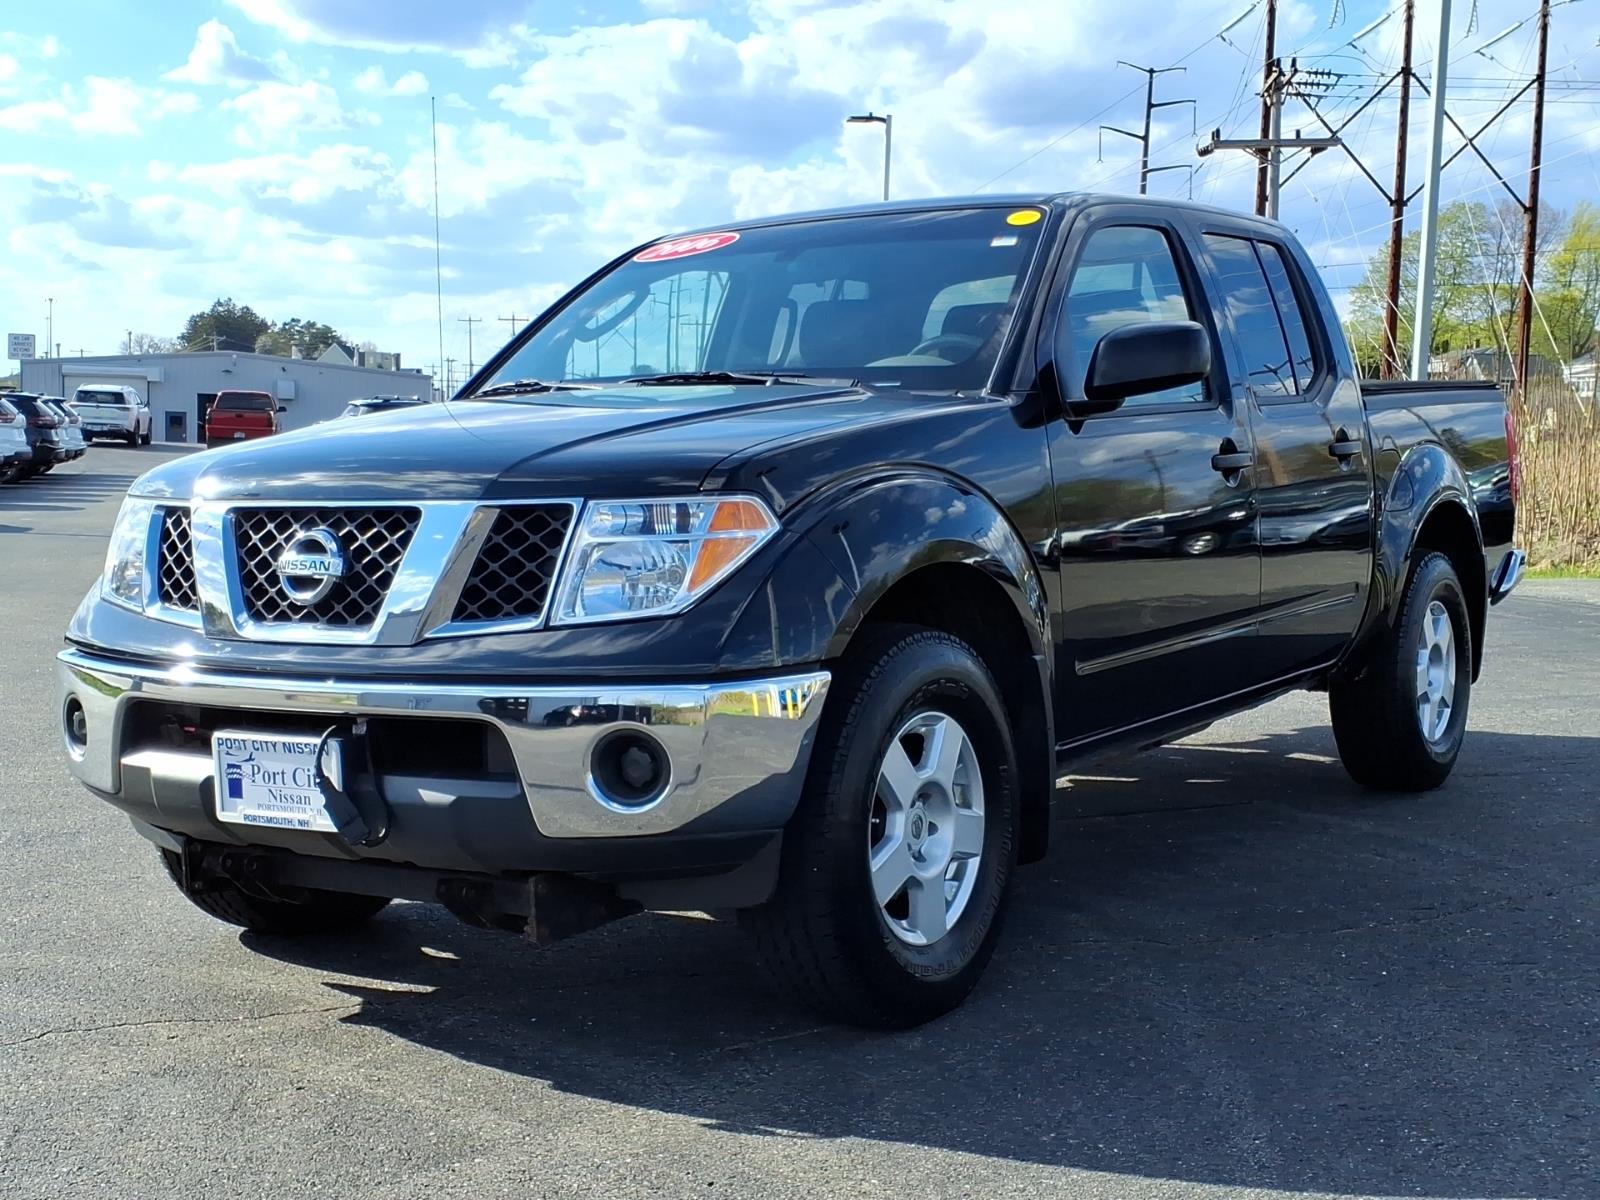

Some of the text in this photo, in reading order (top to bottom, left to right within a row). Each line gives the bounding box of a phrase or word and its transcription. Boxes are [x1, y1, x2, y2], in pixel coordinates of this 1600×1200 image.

[279, 559, 331, 572] NISSAN
[251, 740, 277, 754] CITY
[250, 764, 319, 788] Port Cit
[268, 789, 311, 806] Nissan
[243, 813, 310, 828] PORTSMOUTH, NH
